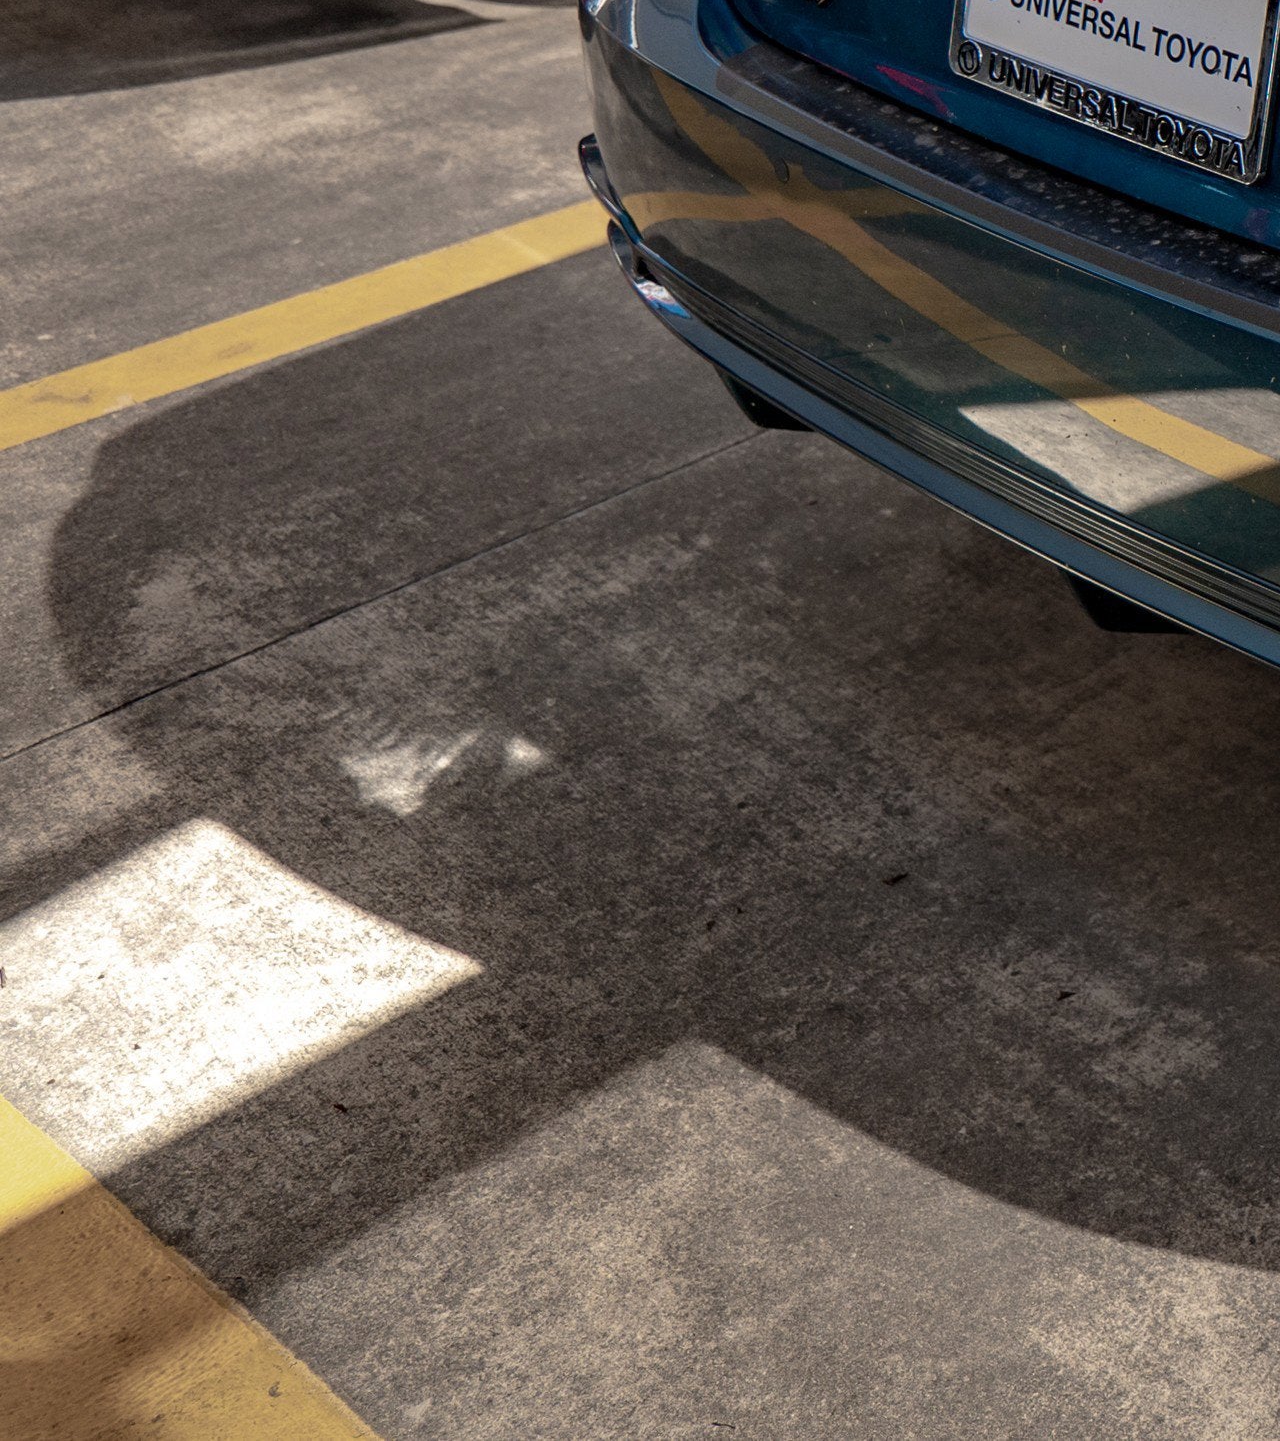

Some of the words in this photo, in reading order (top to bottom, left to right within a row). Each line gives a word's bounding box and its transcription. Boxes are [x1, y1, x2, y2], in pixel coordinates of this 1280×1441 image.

[1152, 26, 1253, 88] TOYOTA
[987, 51, 1135, 131] UNIVERSAL
[1138, 107, 1246, 175] TOYOTA
